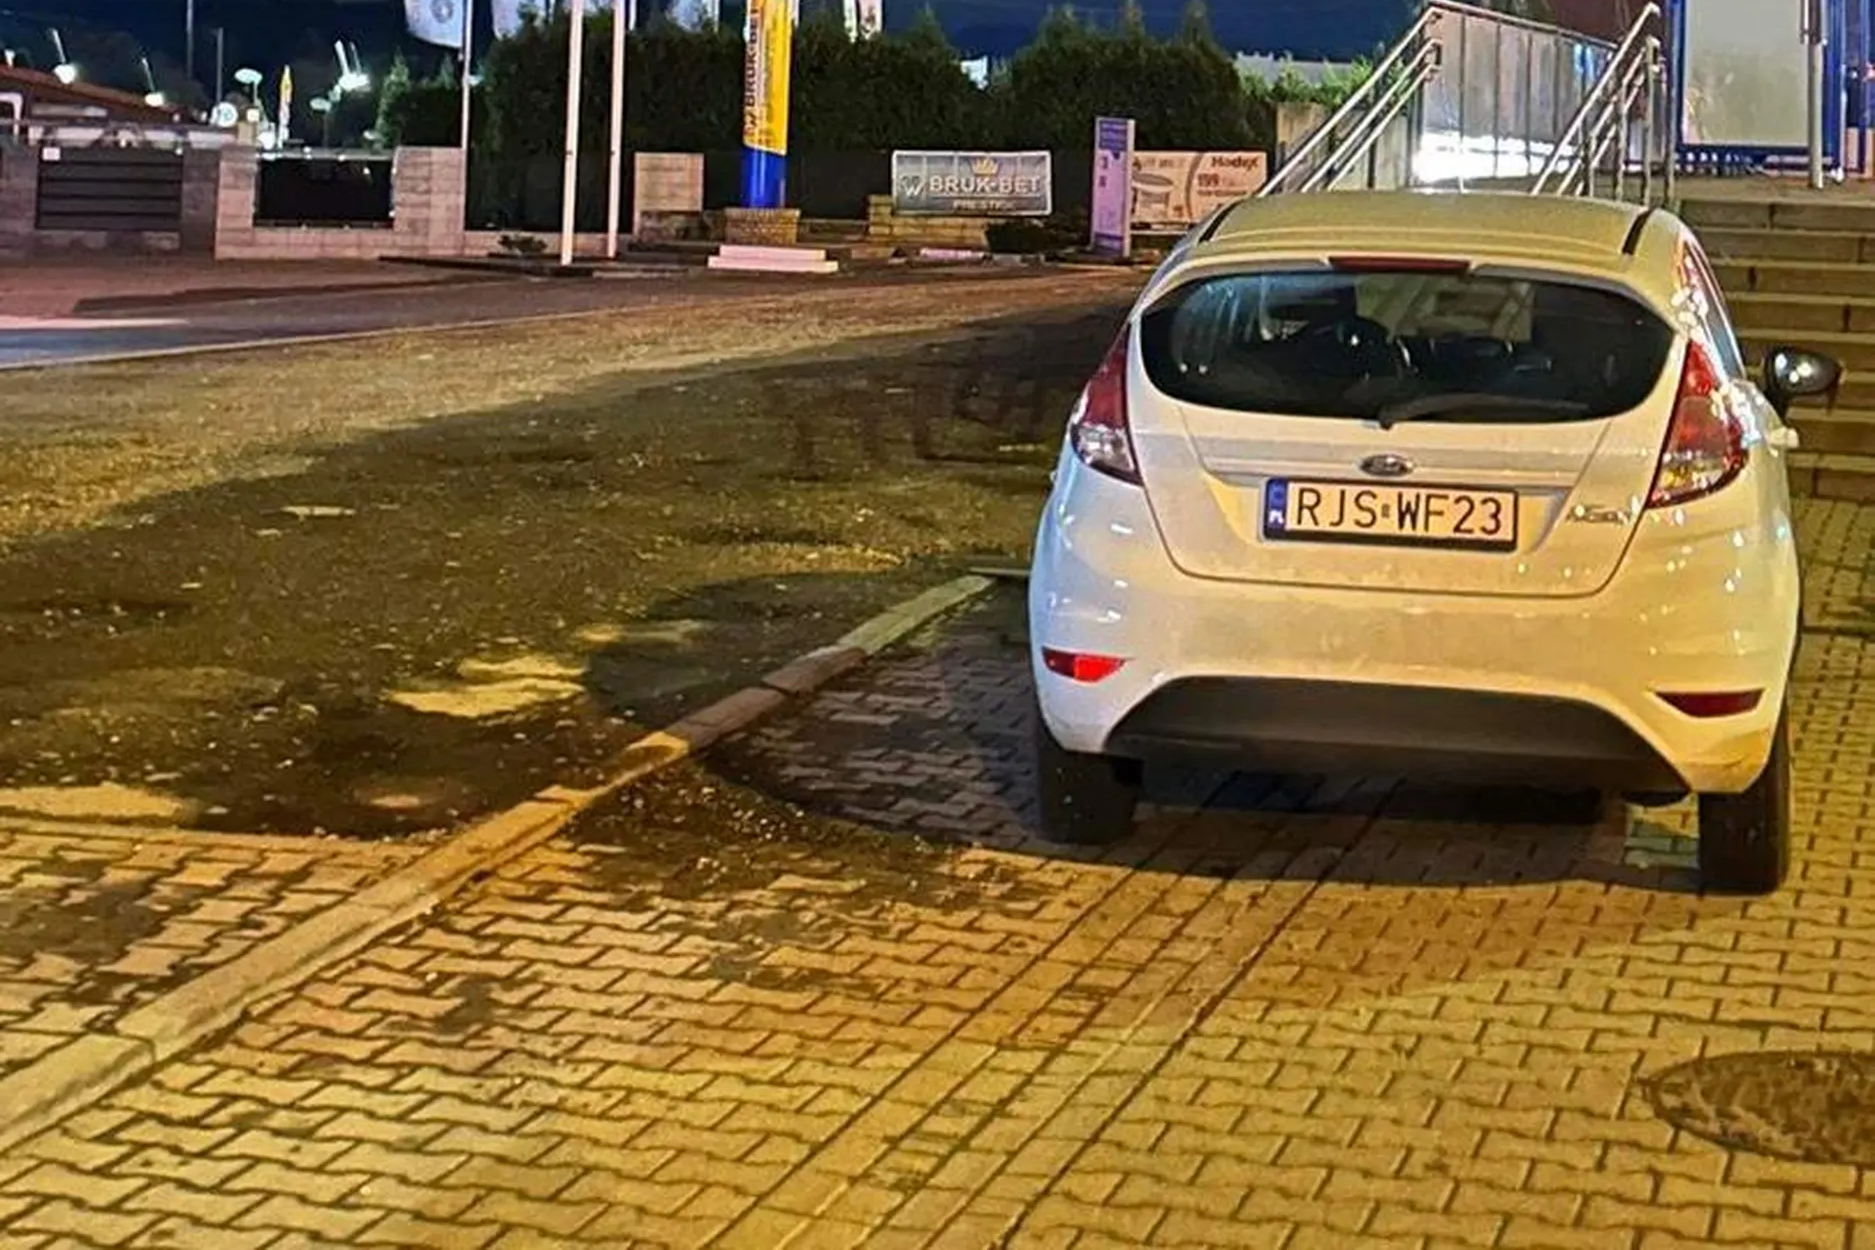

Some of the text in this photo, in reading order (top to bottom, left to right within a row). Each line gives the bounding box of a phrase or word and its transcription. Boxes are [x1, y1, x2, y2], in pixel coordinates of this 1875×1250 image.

[929, 174, 1040, 193] BRUK-BET
[1297, 488, 1502, 536] RJS WF23
